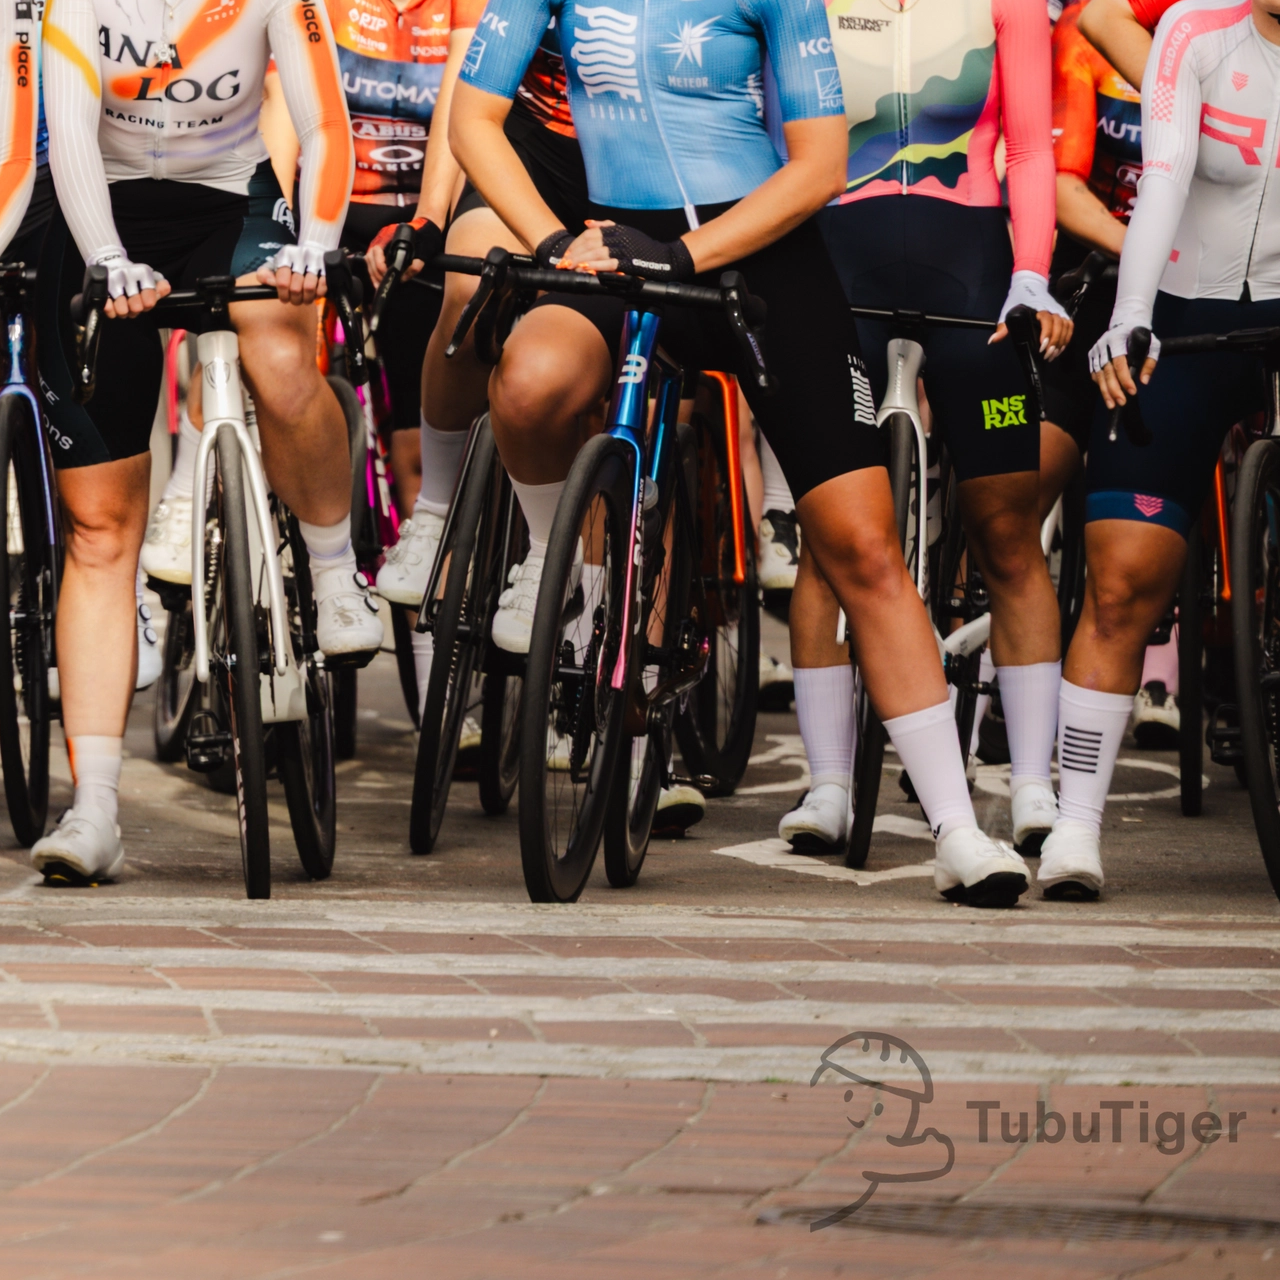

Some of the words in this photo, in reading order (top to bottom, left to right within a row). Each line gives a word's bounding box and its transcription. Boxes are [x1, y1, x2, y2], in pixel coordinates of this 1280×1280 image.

[358, 11, 388, 32] RIP
[837, 15, 892, 28] INSTINCT
[837, 22, 883, 33] RACING
[99, 24, 183, 70] ANA
[15, 31, 32, 88] place
[133, 69, 240, 103] LOG
[342, 71, 440, 105] UTOMA
[667, 74, 709, 89] METEOR
[105, 107, 165, 129] RACING
[176, 115, 224, 129] TEAM
[588, 102, 648, 122] RACING
[358, 123, 426, 138] ABUS
